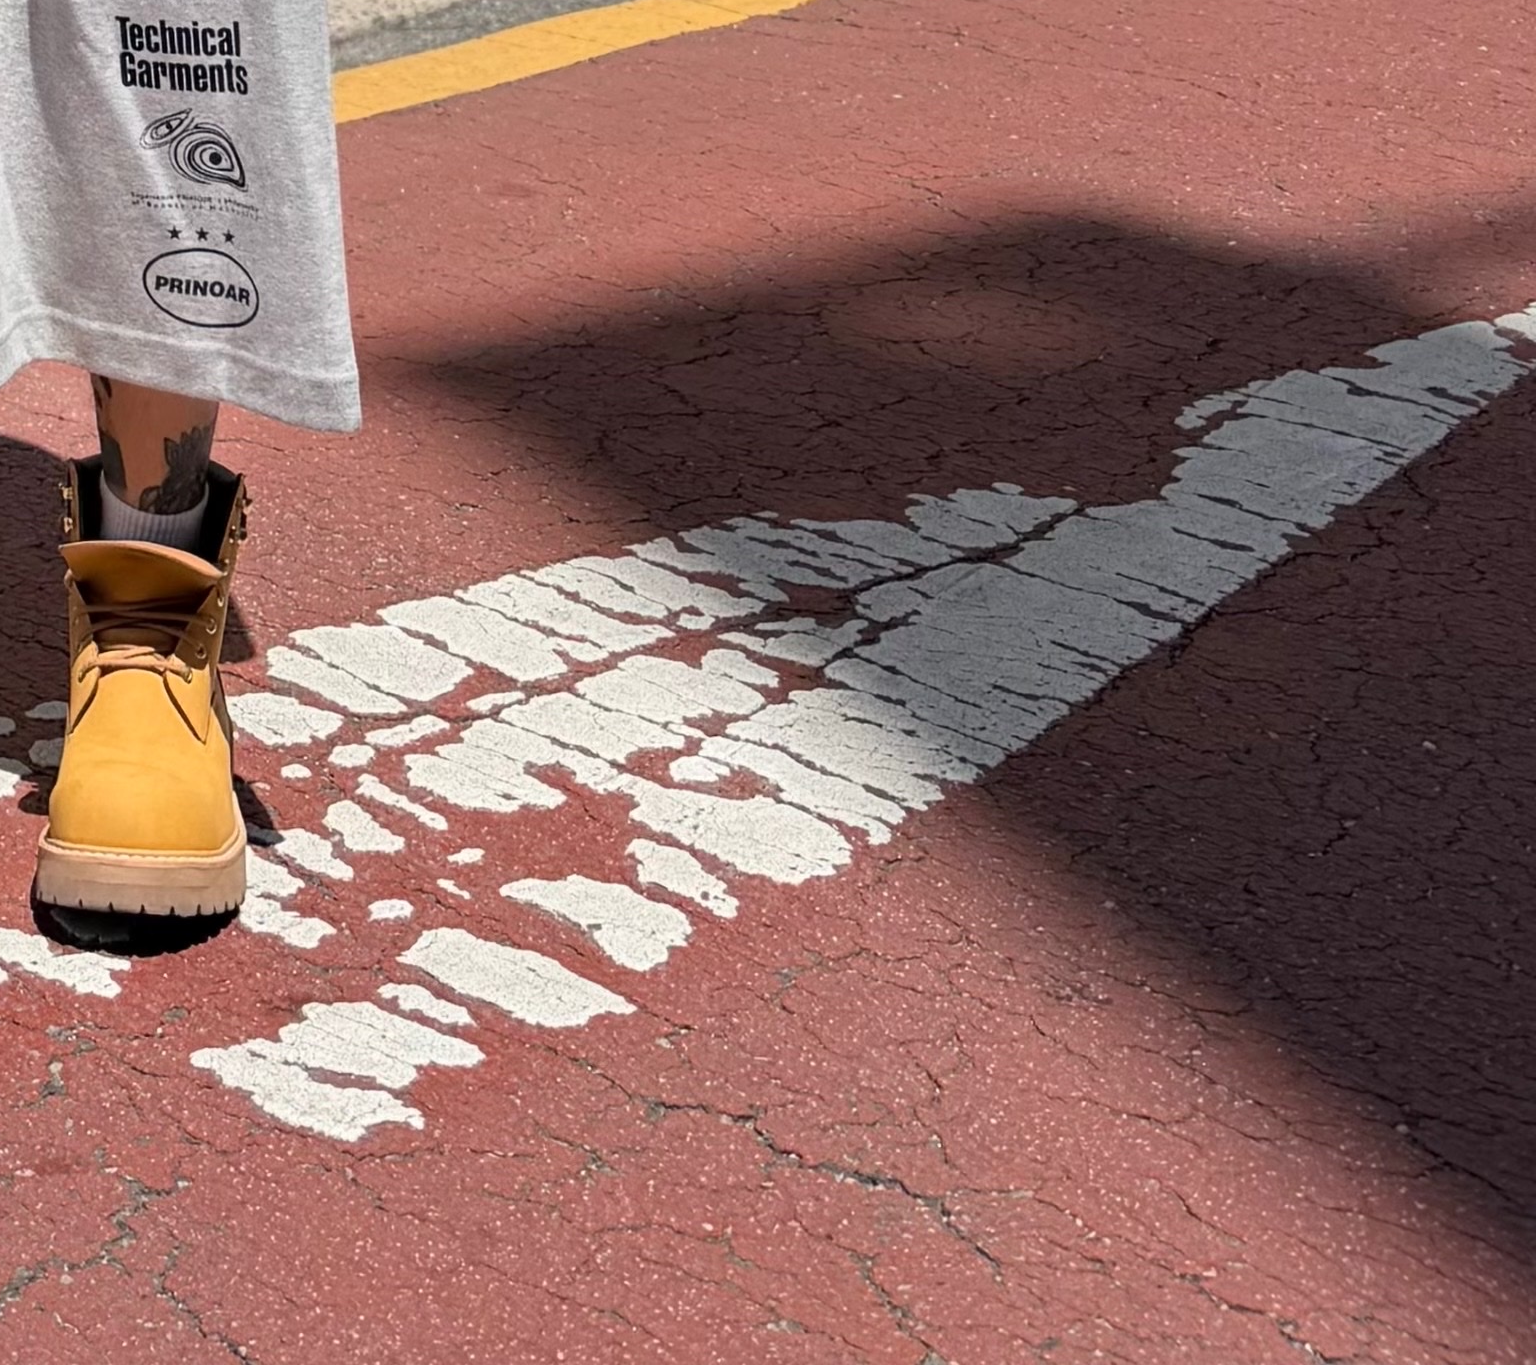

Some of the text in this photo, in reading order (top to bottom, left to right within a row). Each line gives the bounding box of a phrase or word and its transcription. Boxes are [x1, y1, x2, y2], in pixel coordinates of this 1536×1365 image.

[115, 16, 241, 57] Technical
[120, 51, 248, 96] Garments
[154, 275, 251, 307] PRINOAR
